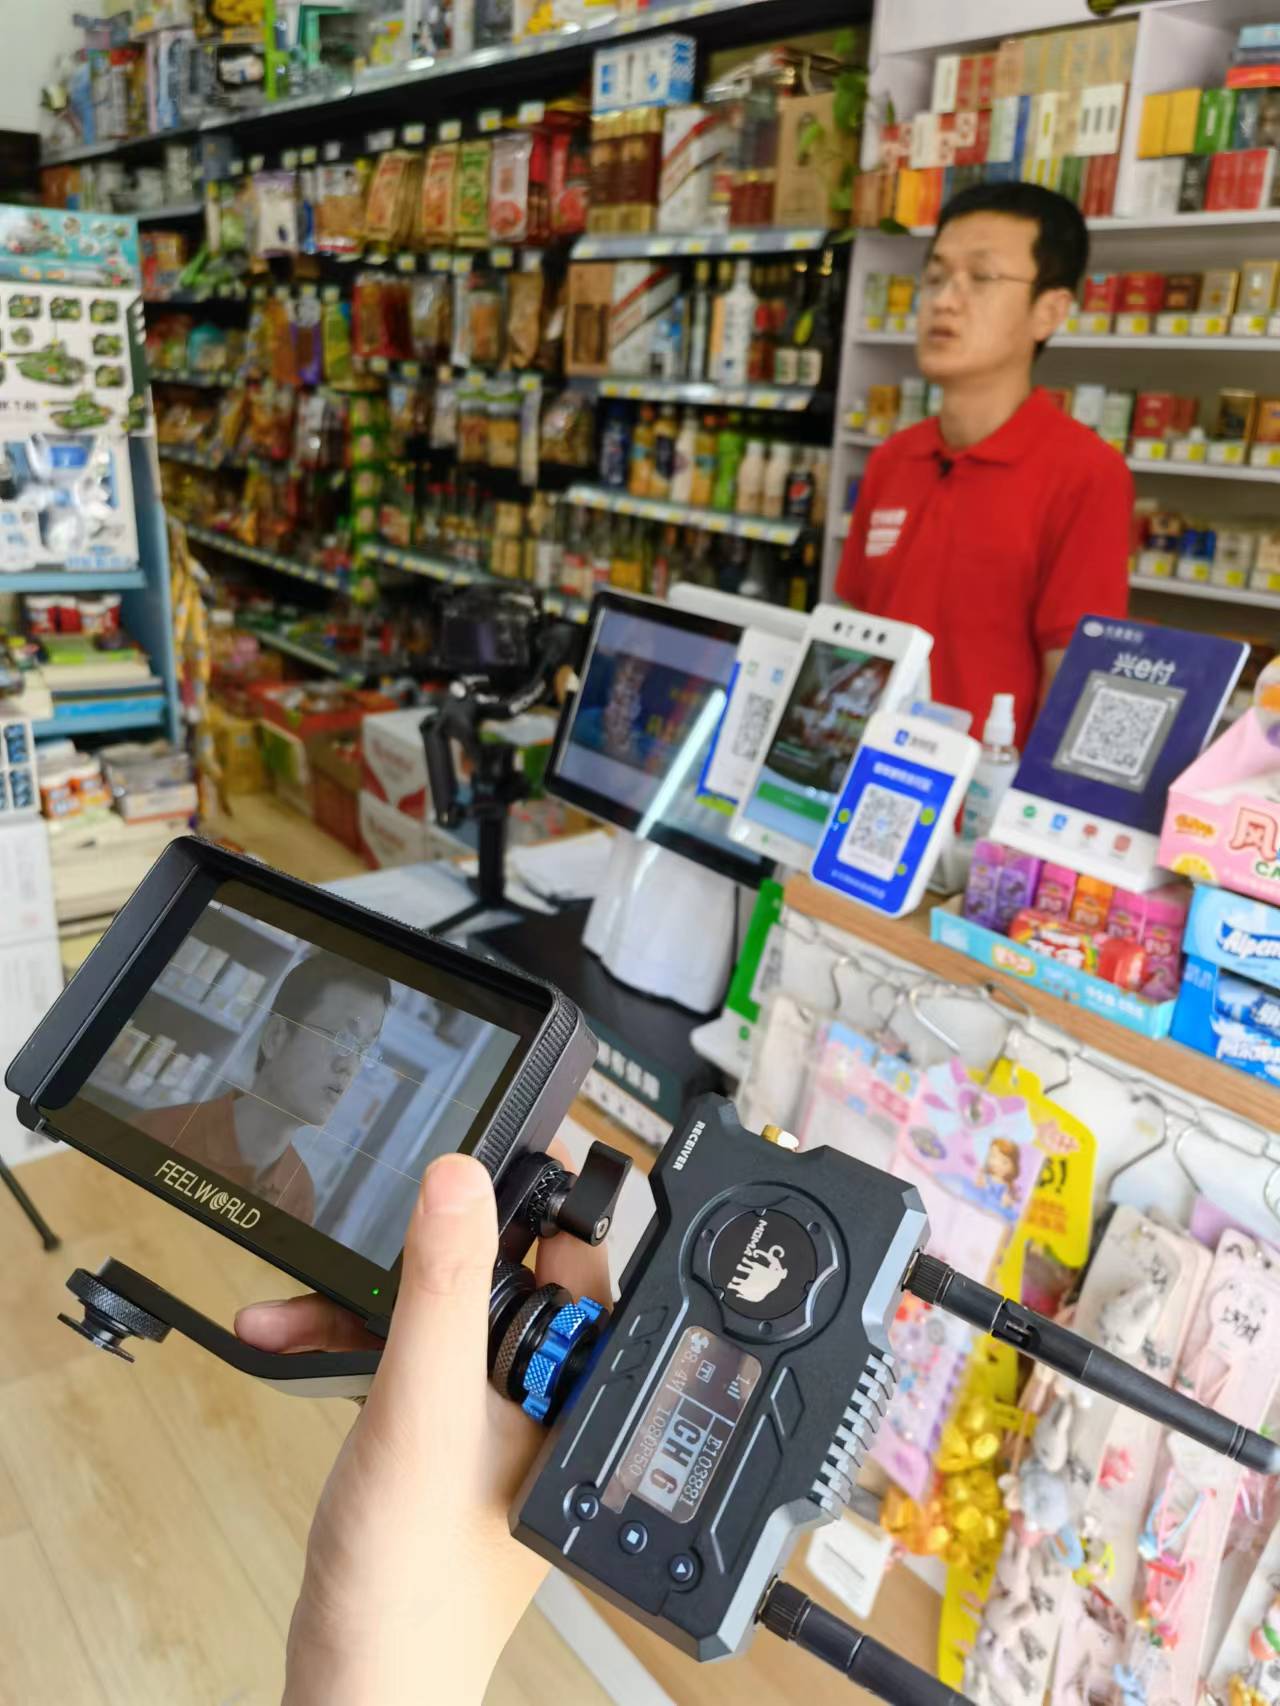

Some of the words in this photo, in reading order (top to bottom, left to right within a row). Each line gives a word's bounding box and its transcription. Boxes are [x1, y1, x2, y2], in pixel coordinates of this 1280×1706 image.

[1111, 651, 1176, 686] 兴e付
[1229, 806, 1280, 862] 风
[672, 1120, 706, 1171] RECEIVER
[154, 1160, 260, 1229] FEELWORLD
[744, 1219, 768, 1256] MOMA
[630, 1407, 672, 1476] 1080P50
[661, 1419, 702, 1467] CH
[651, 1468, 678, 1494] 6
[679, 1434, 723, 1506] E103881
